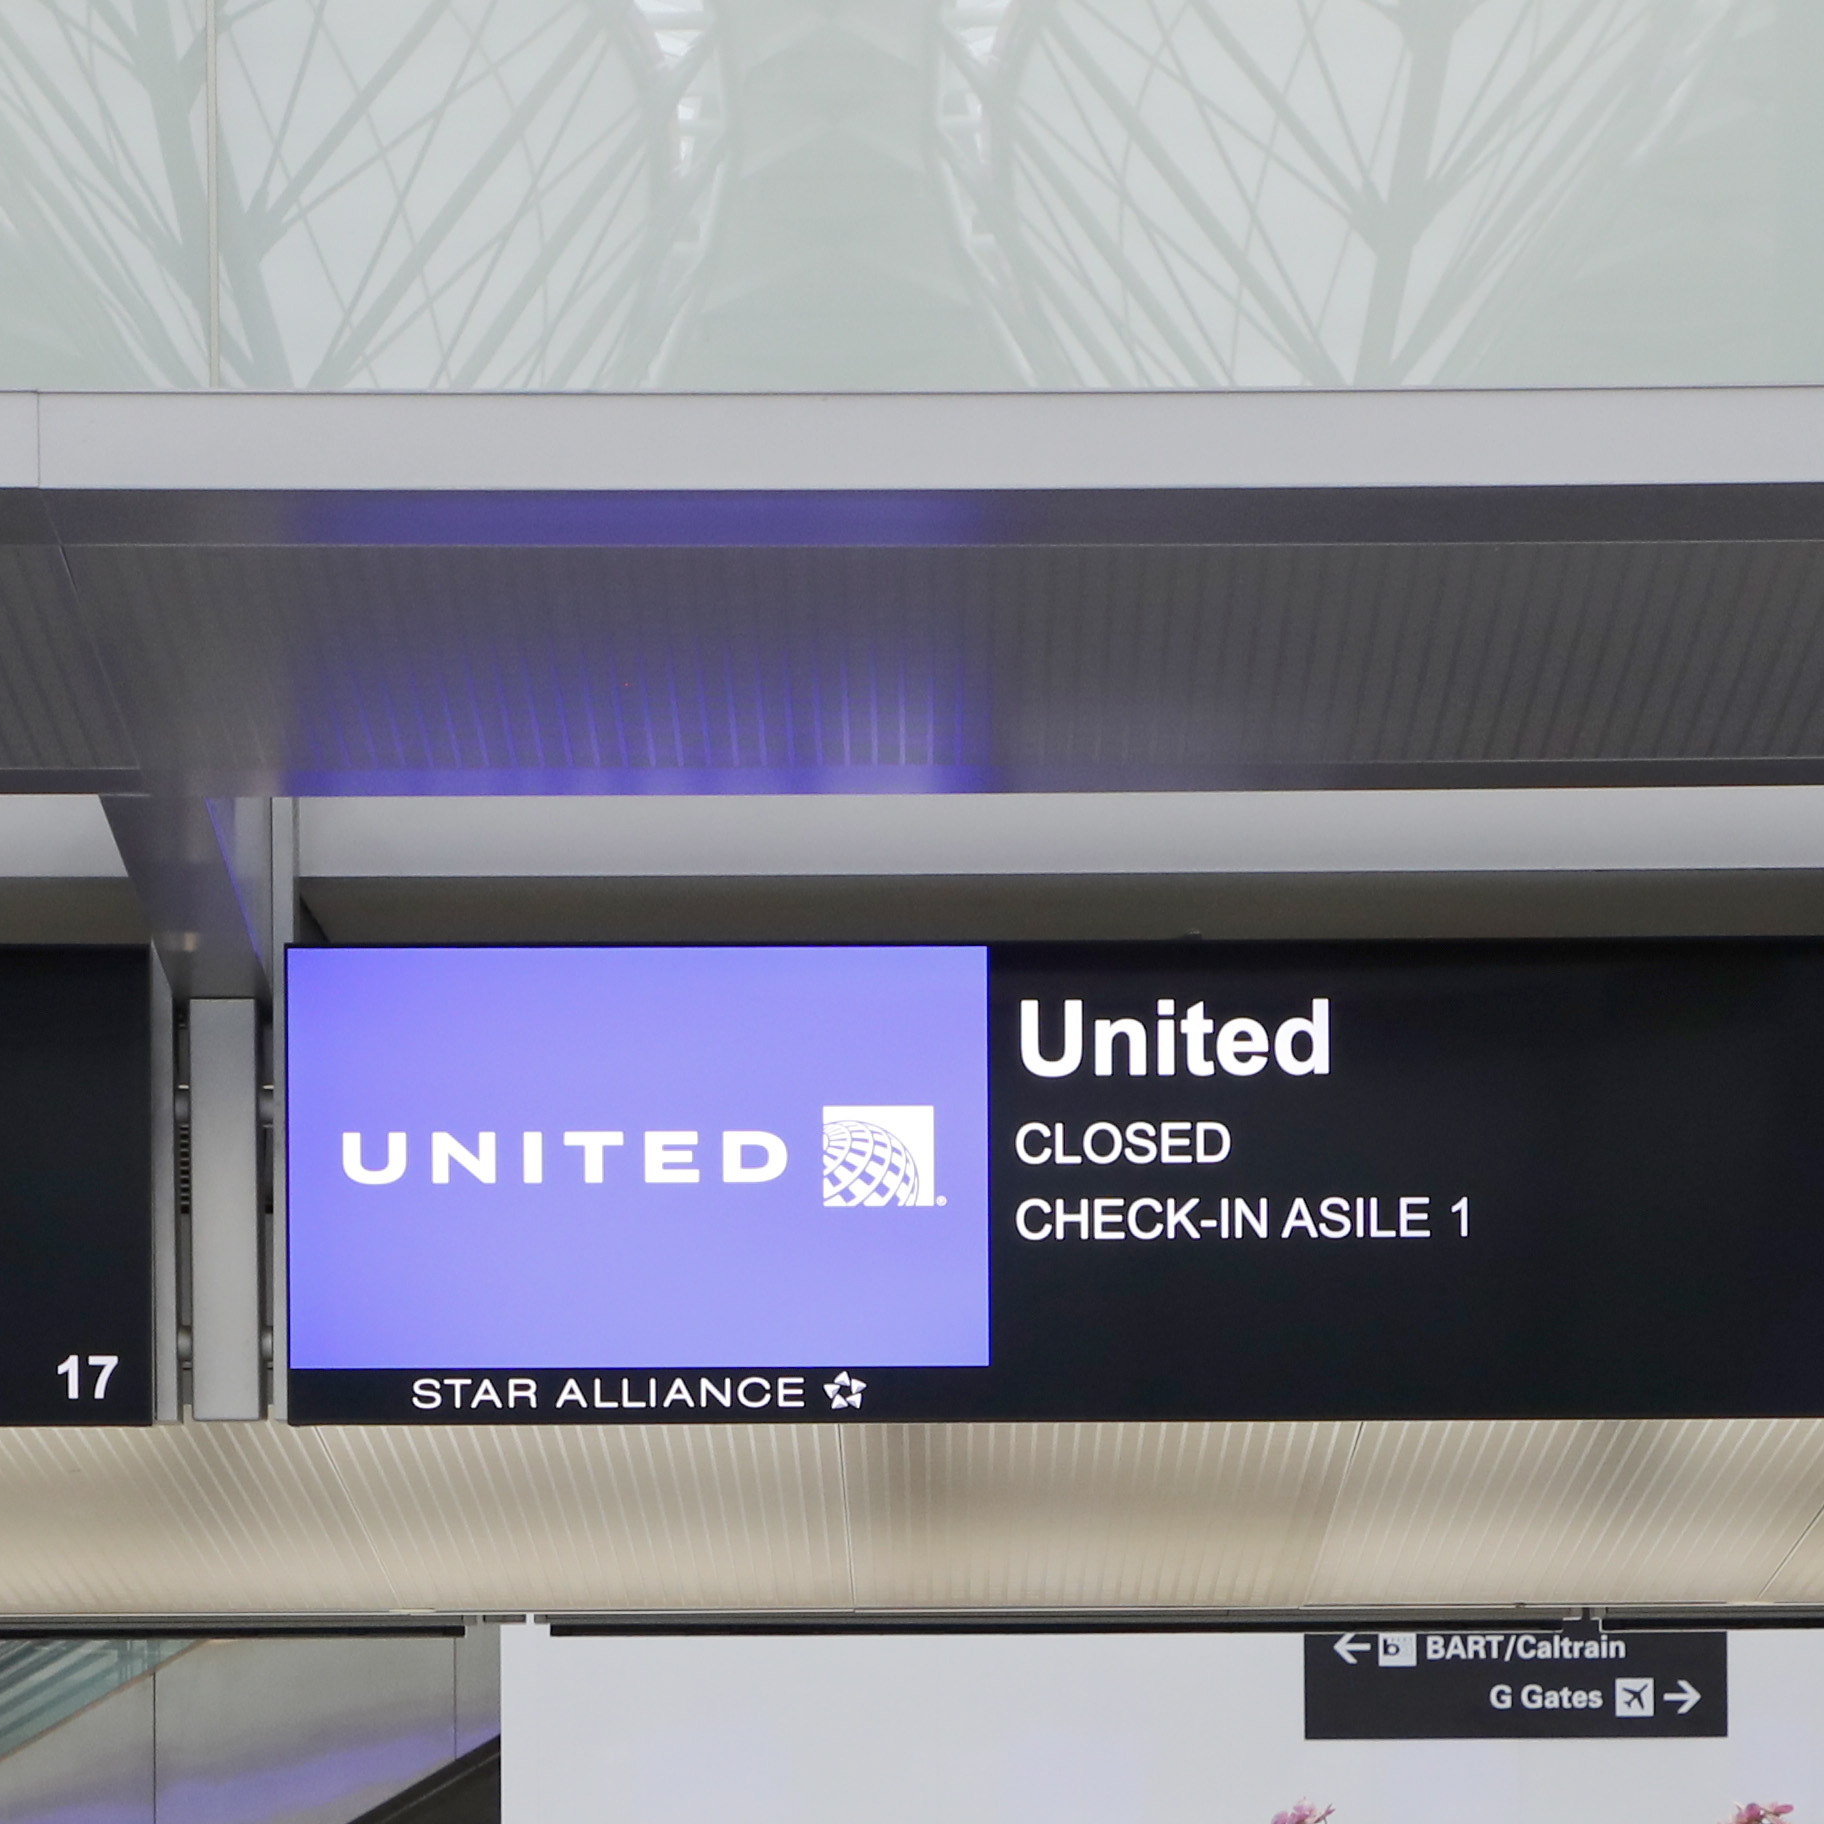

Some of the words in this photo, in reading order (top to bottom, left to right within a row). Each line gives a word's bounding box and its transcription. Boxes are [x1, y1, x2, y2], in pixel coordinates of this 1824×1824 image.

[1020, 997, 1330, 1078] United
[342, 1130, 789, 1185] UNITED
[1015, 1121, 1231, 1165] CLOSED
[1015, 1197, 1268, 1241] CHECK-IN
[1281, 1196, 1431, 1240] ASILE
[1451, 1196, 1469, 1238] 1
[57, 1354, 119, 1401] 17
[412, 1377, 538, 1410] STAR
[555, 1375, 806, 1409] ALLIANCE
[1426, 1635, 1626, 1662] BART/Caltrain
[1489, 1684, 1512, 1709] G
[1520, 1684, 1603, 1710] Gates
